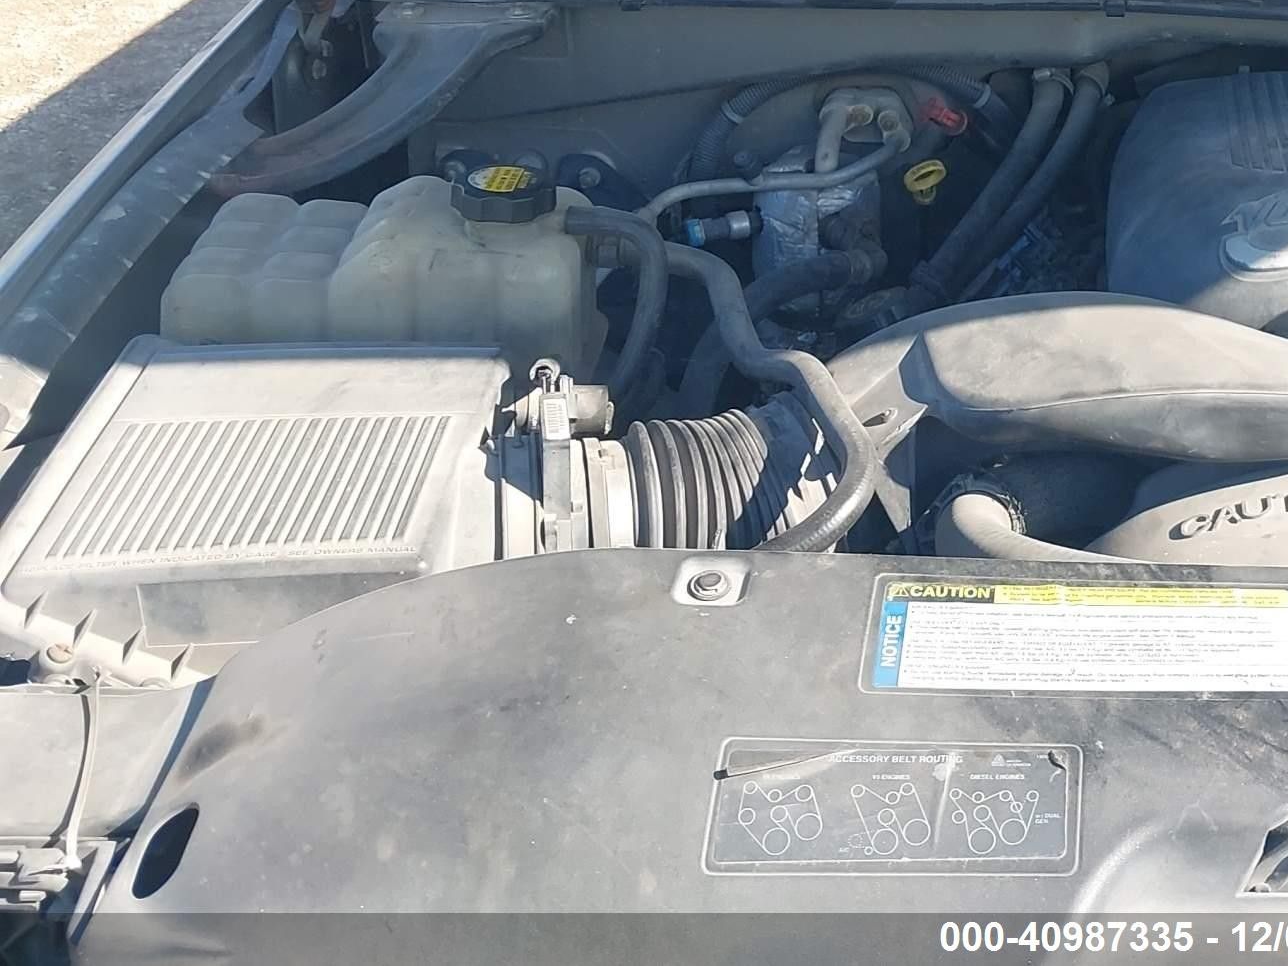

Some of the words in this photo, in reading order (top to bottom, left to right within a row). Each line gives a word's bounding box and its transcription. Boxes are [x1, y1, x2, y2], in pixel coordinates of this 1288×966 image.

[909, 585, 992, 599] CAUTION
[879, 614, 904, 668] NOTICE
[829, 753, 889, 764] ACCESSORY
[891, 754, 917, 764] BELT
[918, 754, 964, 764] ROUTING
